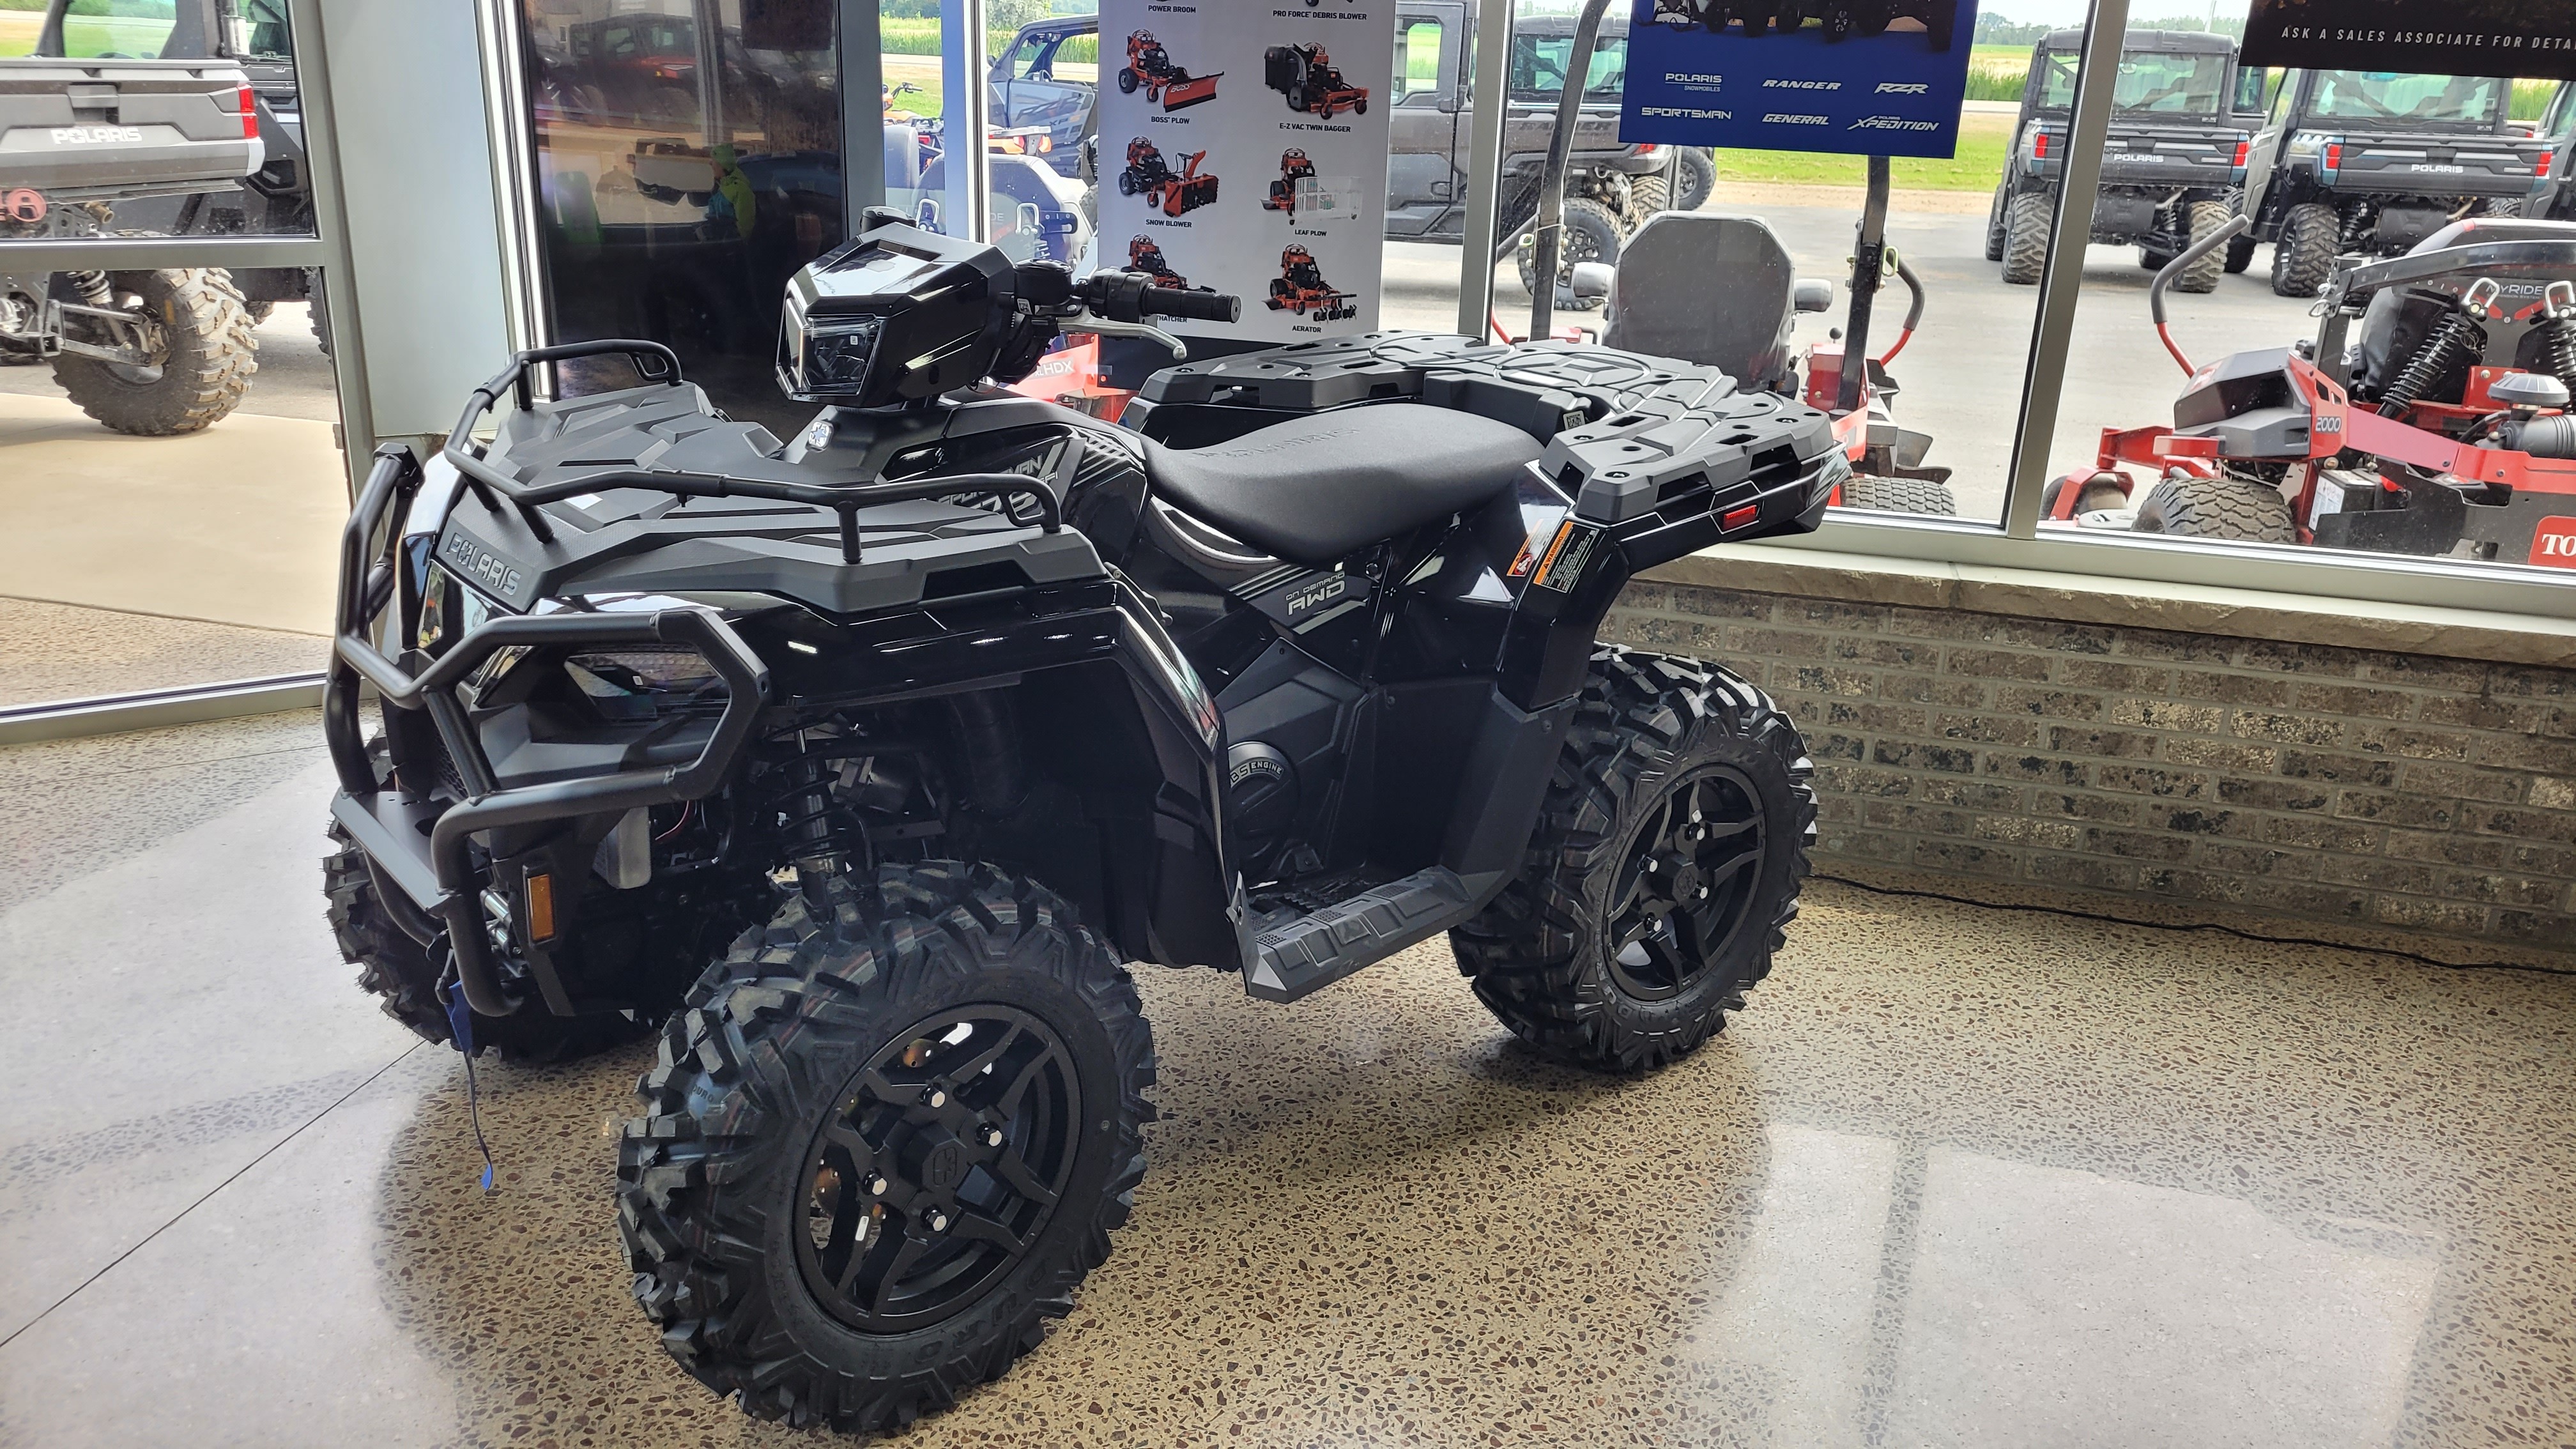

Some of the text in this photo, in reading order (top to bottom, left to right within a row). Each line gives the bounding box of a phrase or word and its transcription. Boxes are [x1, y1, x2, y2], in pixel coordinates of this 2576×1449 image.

[2281, 27, 2576, 50] ASK A SALES ASSOCIATE FOR DETA
[1665, 73, 1722, 83] POLARIS
[1762, 79, 1842, 90] RANGER
[1873, 82, 1929, 95] RZR
[1641, 107, 1733, 119] SPORTSMAN
[1762, 114, 1829, 125] GENERAL
[1846, 115, 1940, 131] XPEDITION
[50, 127, 142, 145] POLARIS
[2113, 153, 2165, 163] POLARIS
[2411, 164, 2464, 174] POLARIS
[1166, 220, 1192, 228] BLOWER
[1043, 360, 1076, 375] HDX
[2315, 417, 2342, 432] 2000
[2541, 533, 2576, 557] TO
[446, 532, 521, 595] POLARIS
[1285, 571, 1345, 601] ON DEMAND
[1288, 579, 1346, 616] AWD
[1250, 760, 1282, 775] ENGINE
